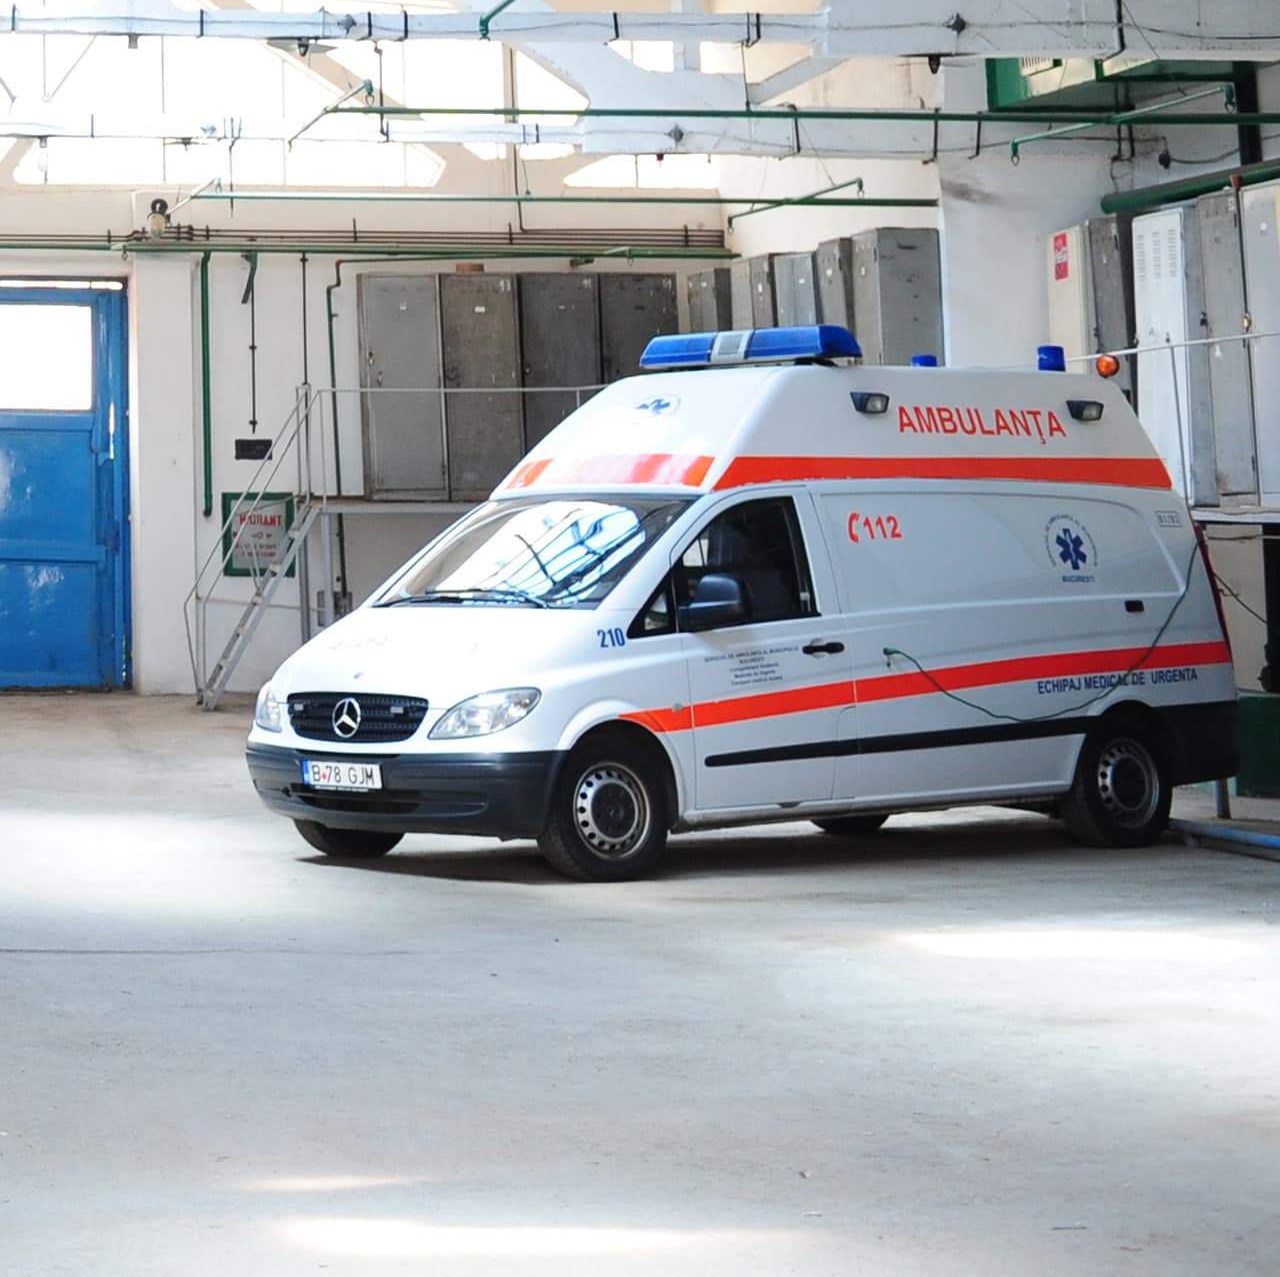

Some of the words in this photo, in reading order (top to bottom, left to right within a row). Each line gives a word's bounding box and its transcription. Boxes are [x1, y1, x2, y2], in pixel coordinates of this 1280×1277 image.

[863, 515, 903, 540] 112
[597, 627, 626, 648] 210
[1037, 679, 1081, 694] ECHIPAJ
[1084, 673, 1129, 689] MEDICAL
[1131, 672, 1146, 685] DE
[1151, 668, 1198, 683] URGENTA
[312, 764, 320, 782] B
[326, 765, 342, 784] 78
